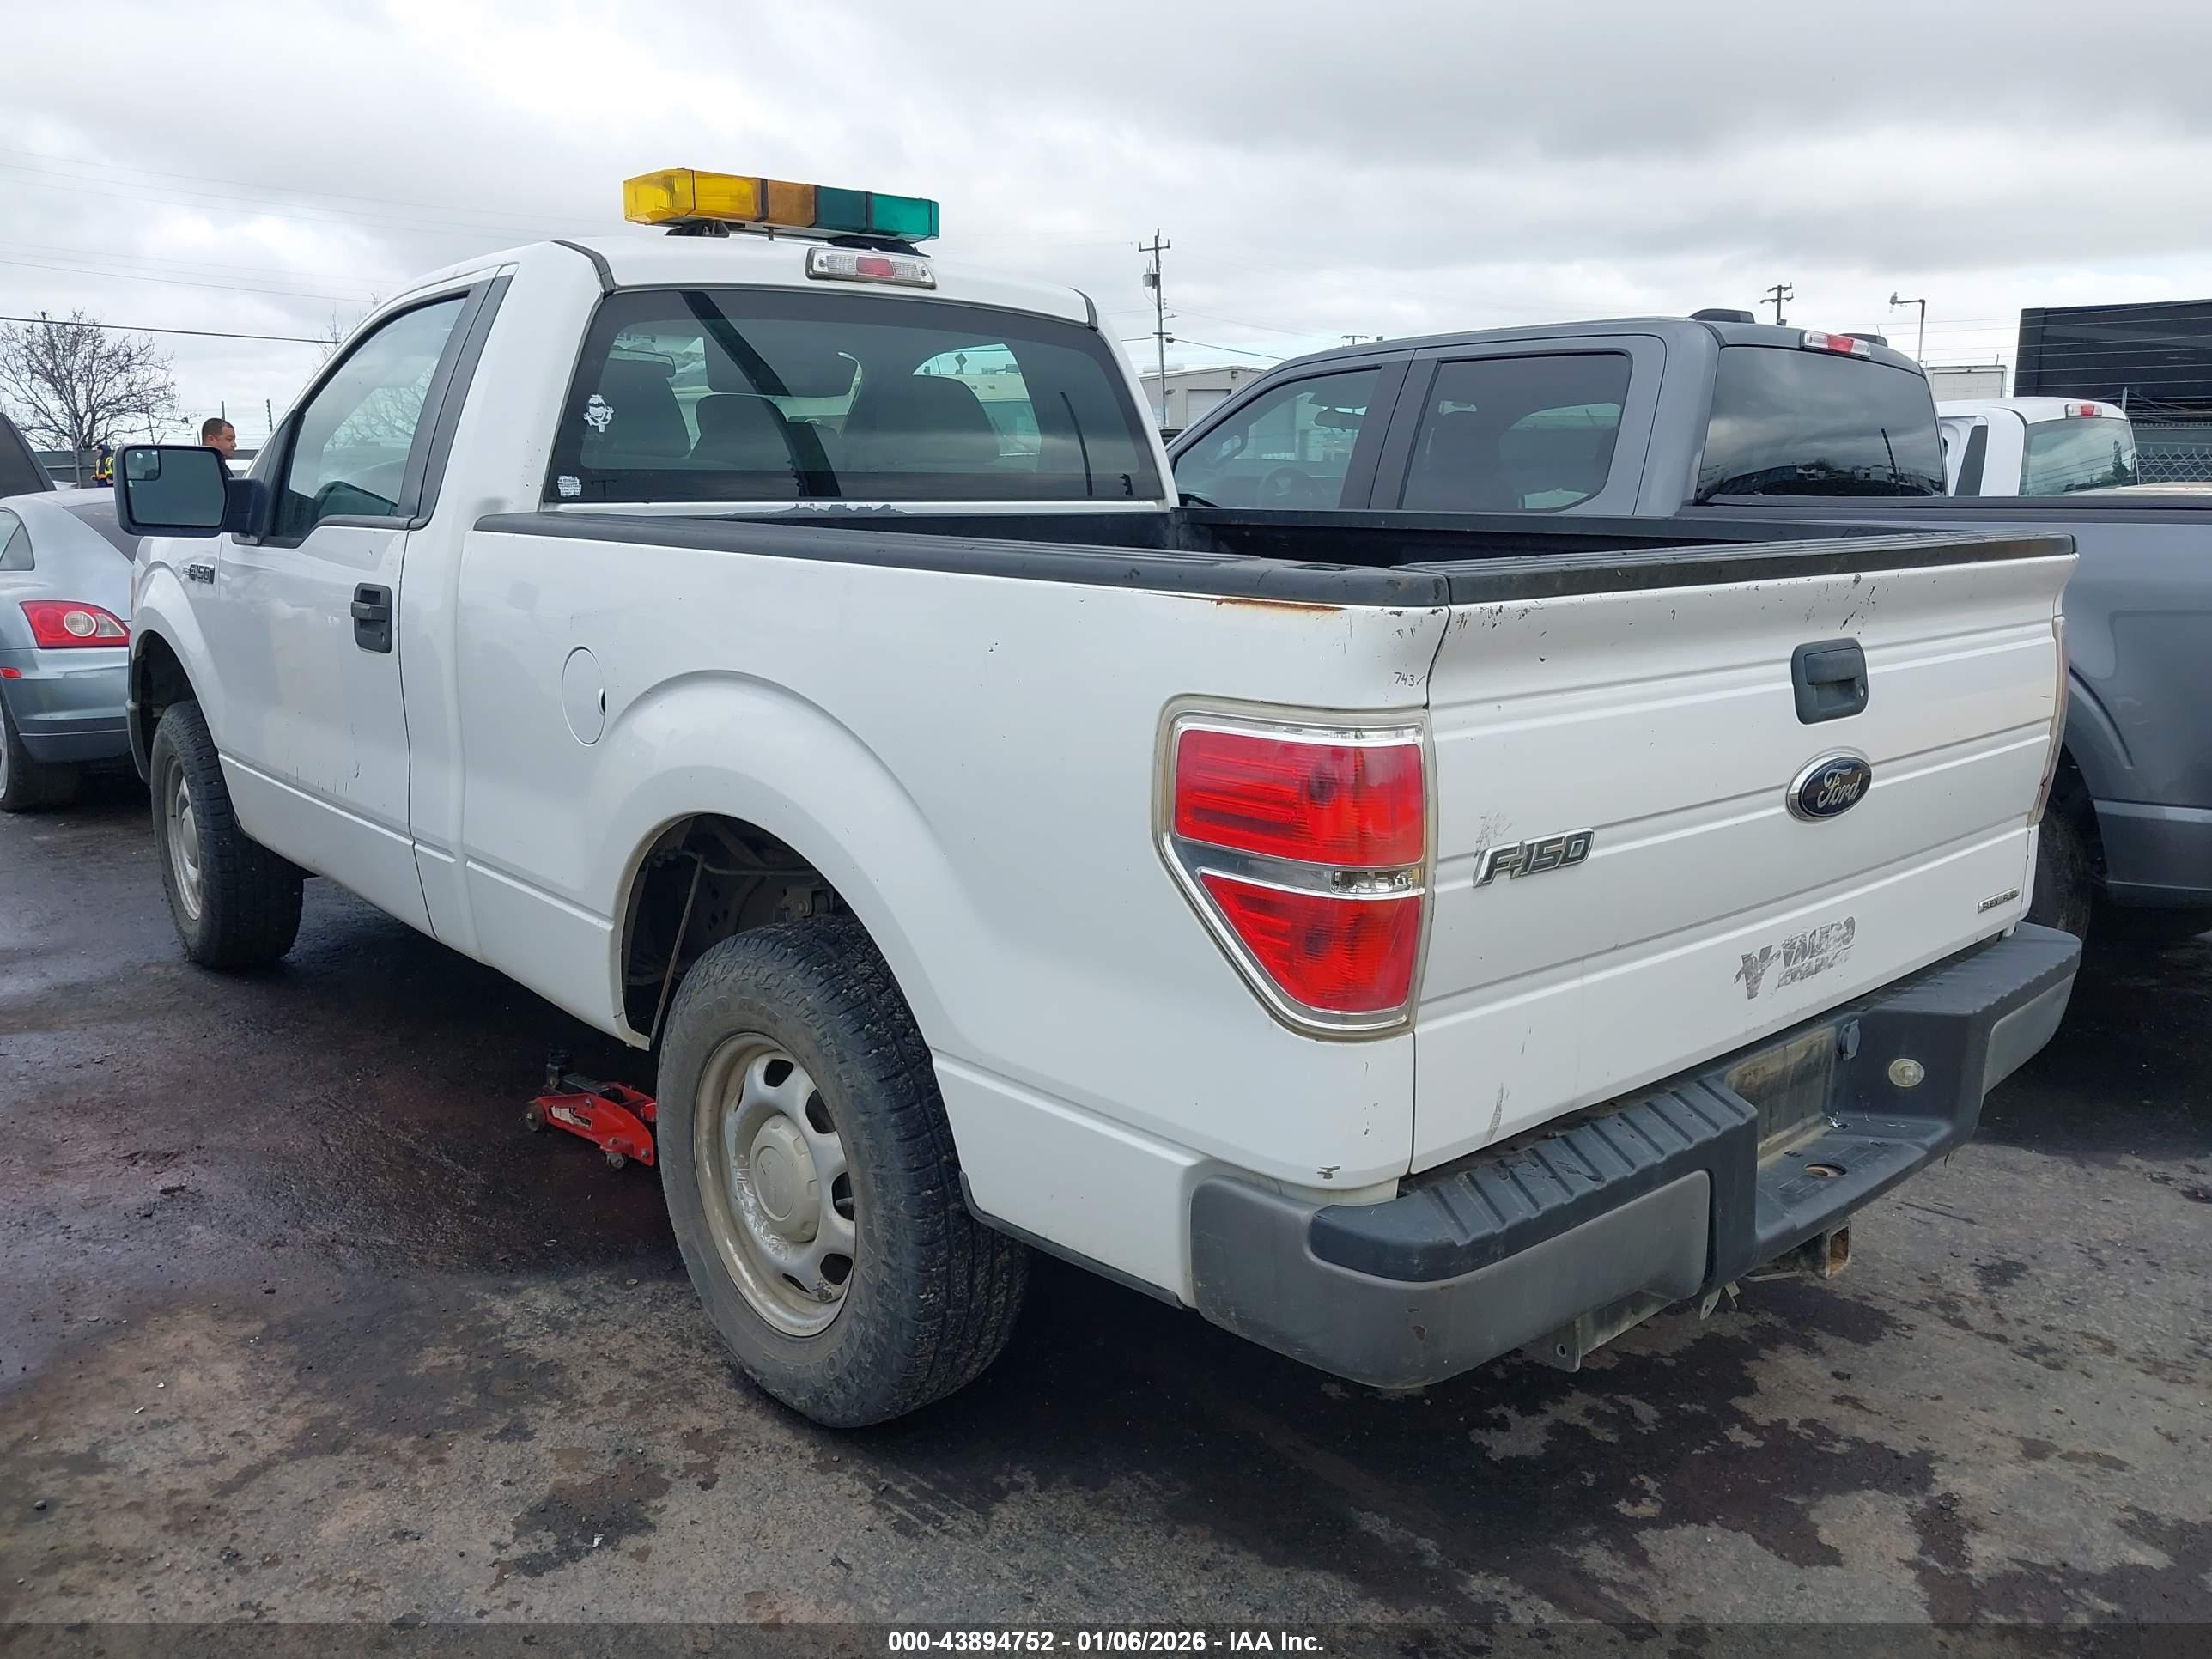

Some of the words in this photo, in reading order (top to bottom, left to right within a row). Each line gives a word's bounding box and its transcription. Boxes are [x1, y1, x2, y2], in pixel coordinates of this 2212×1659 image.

[1393, 672, 1415, 687] 743
[1817, 767, 1863, 809] Ford
[1472, 827, 1595, 889] F-150
